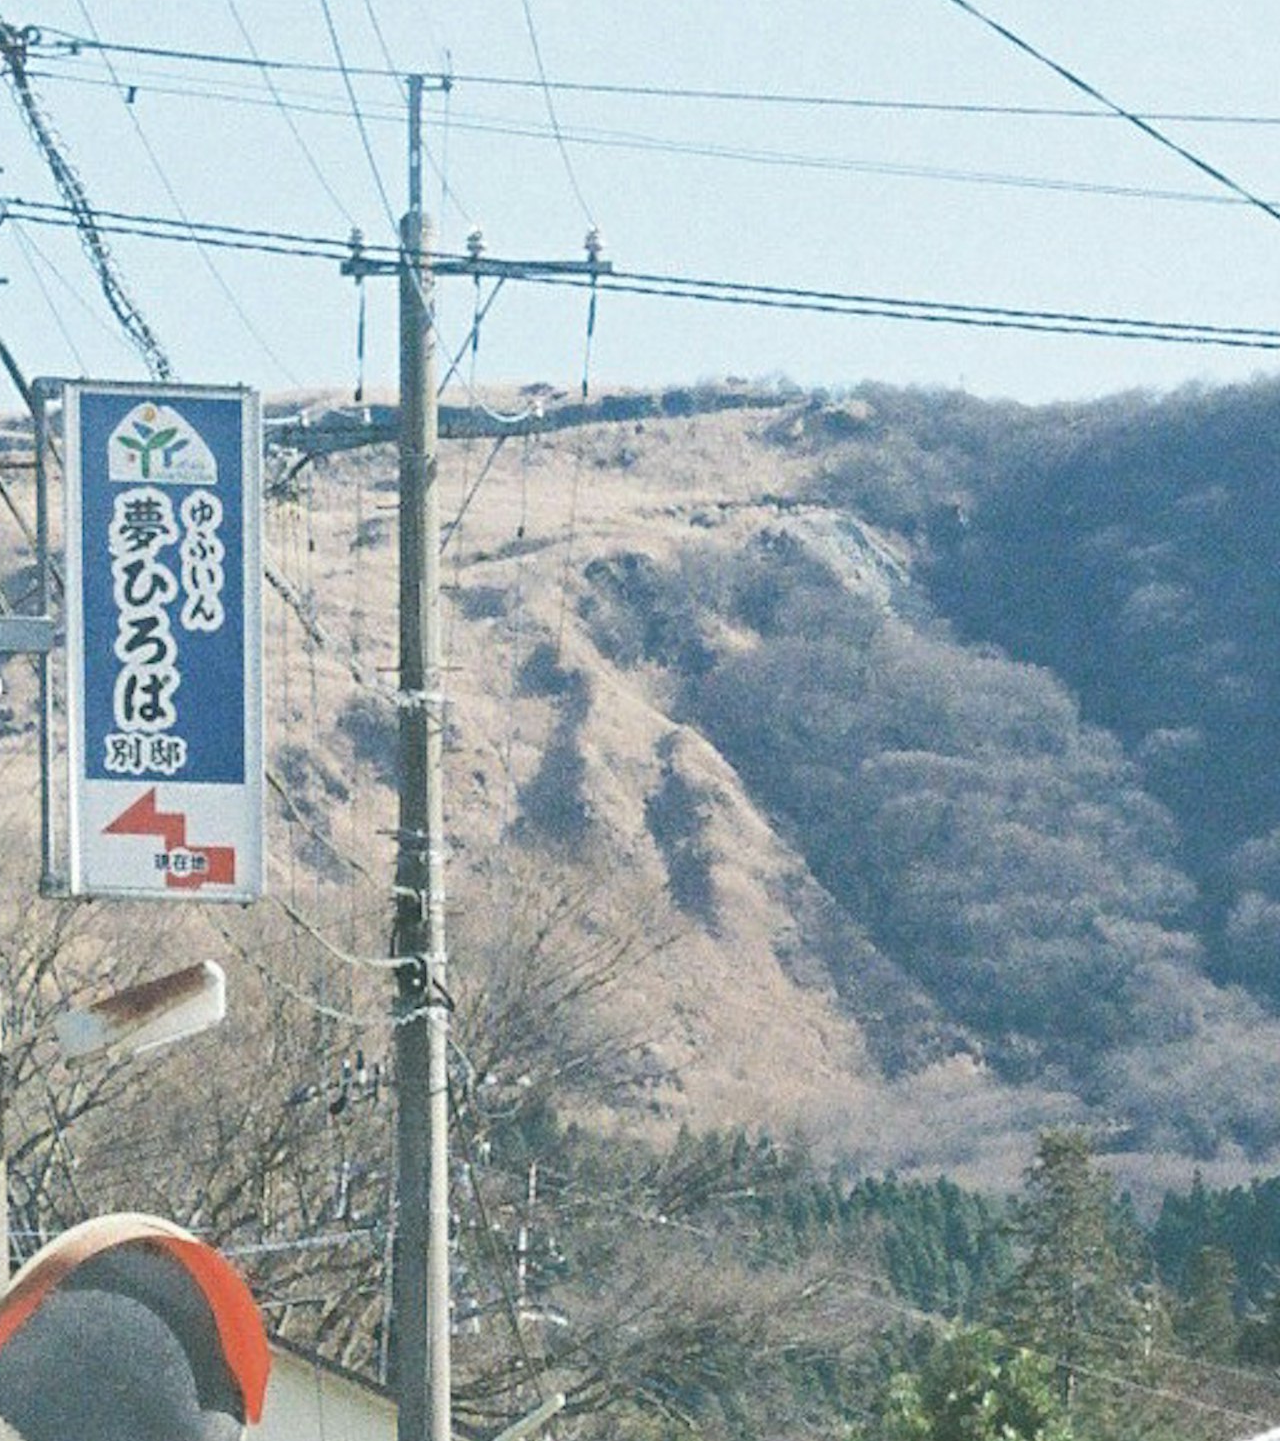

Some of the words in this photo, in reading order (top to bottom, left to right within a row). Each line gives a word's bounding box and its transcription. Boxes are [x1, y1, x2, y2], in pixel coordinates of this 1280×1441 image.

[189, 498, 216, 623] ゆふいん
[118, 497, 171, 721] 夢ひろば
[111, 738, 181, 769] 別邸
[154, 852, 207, 871] 現在地
